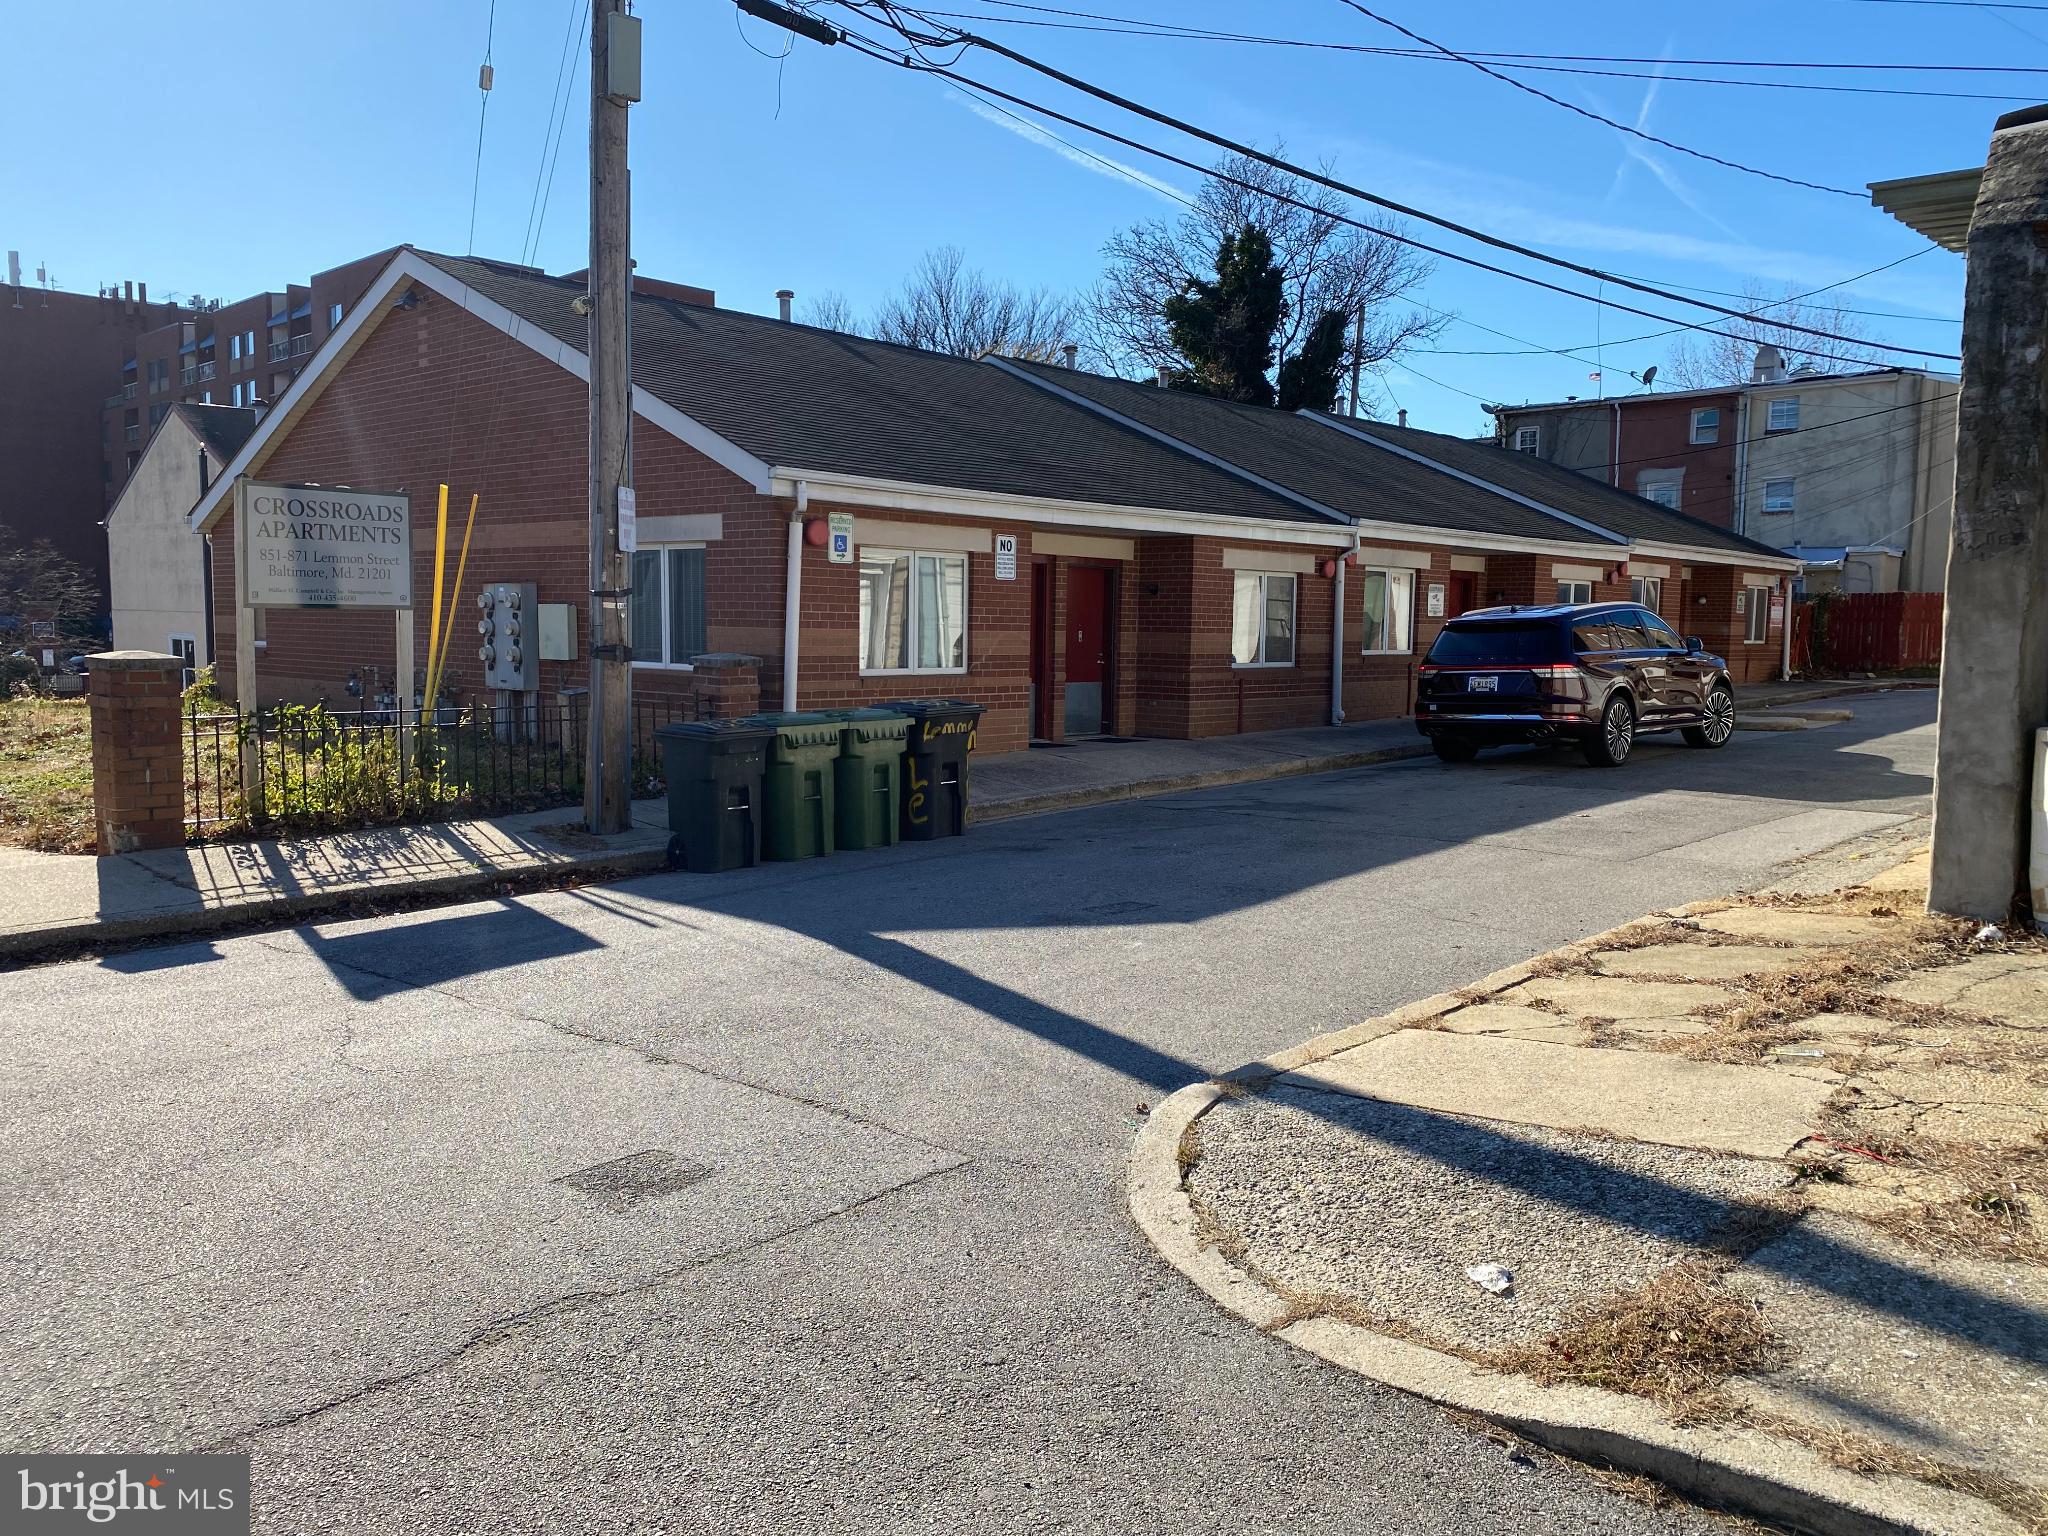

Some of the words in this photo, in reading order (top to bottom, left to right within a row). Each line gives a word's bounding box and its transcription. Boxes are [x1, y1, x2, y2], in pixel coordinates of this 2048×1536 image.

[254, 497, 404, 523] CROSSROADS
[256, 521, 402, 544] APARTMENTS
[831, 525, 851, 534] PARKING
[1000, 540, 1012, 552] NO
[259, 549, 308, 562] 851-871
[313, 551, 363, 565] Lemmon
[367, 553, 401, 566] Street
[268, 565, 328, 581] Baltimore,
[332, 567, 355, 579] Md.
[358, 568, 392, 580] 21201
